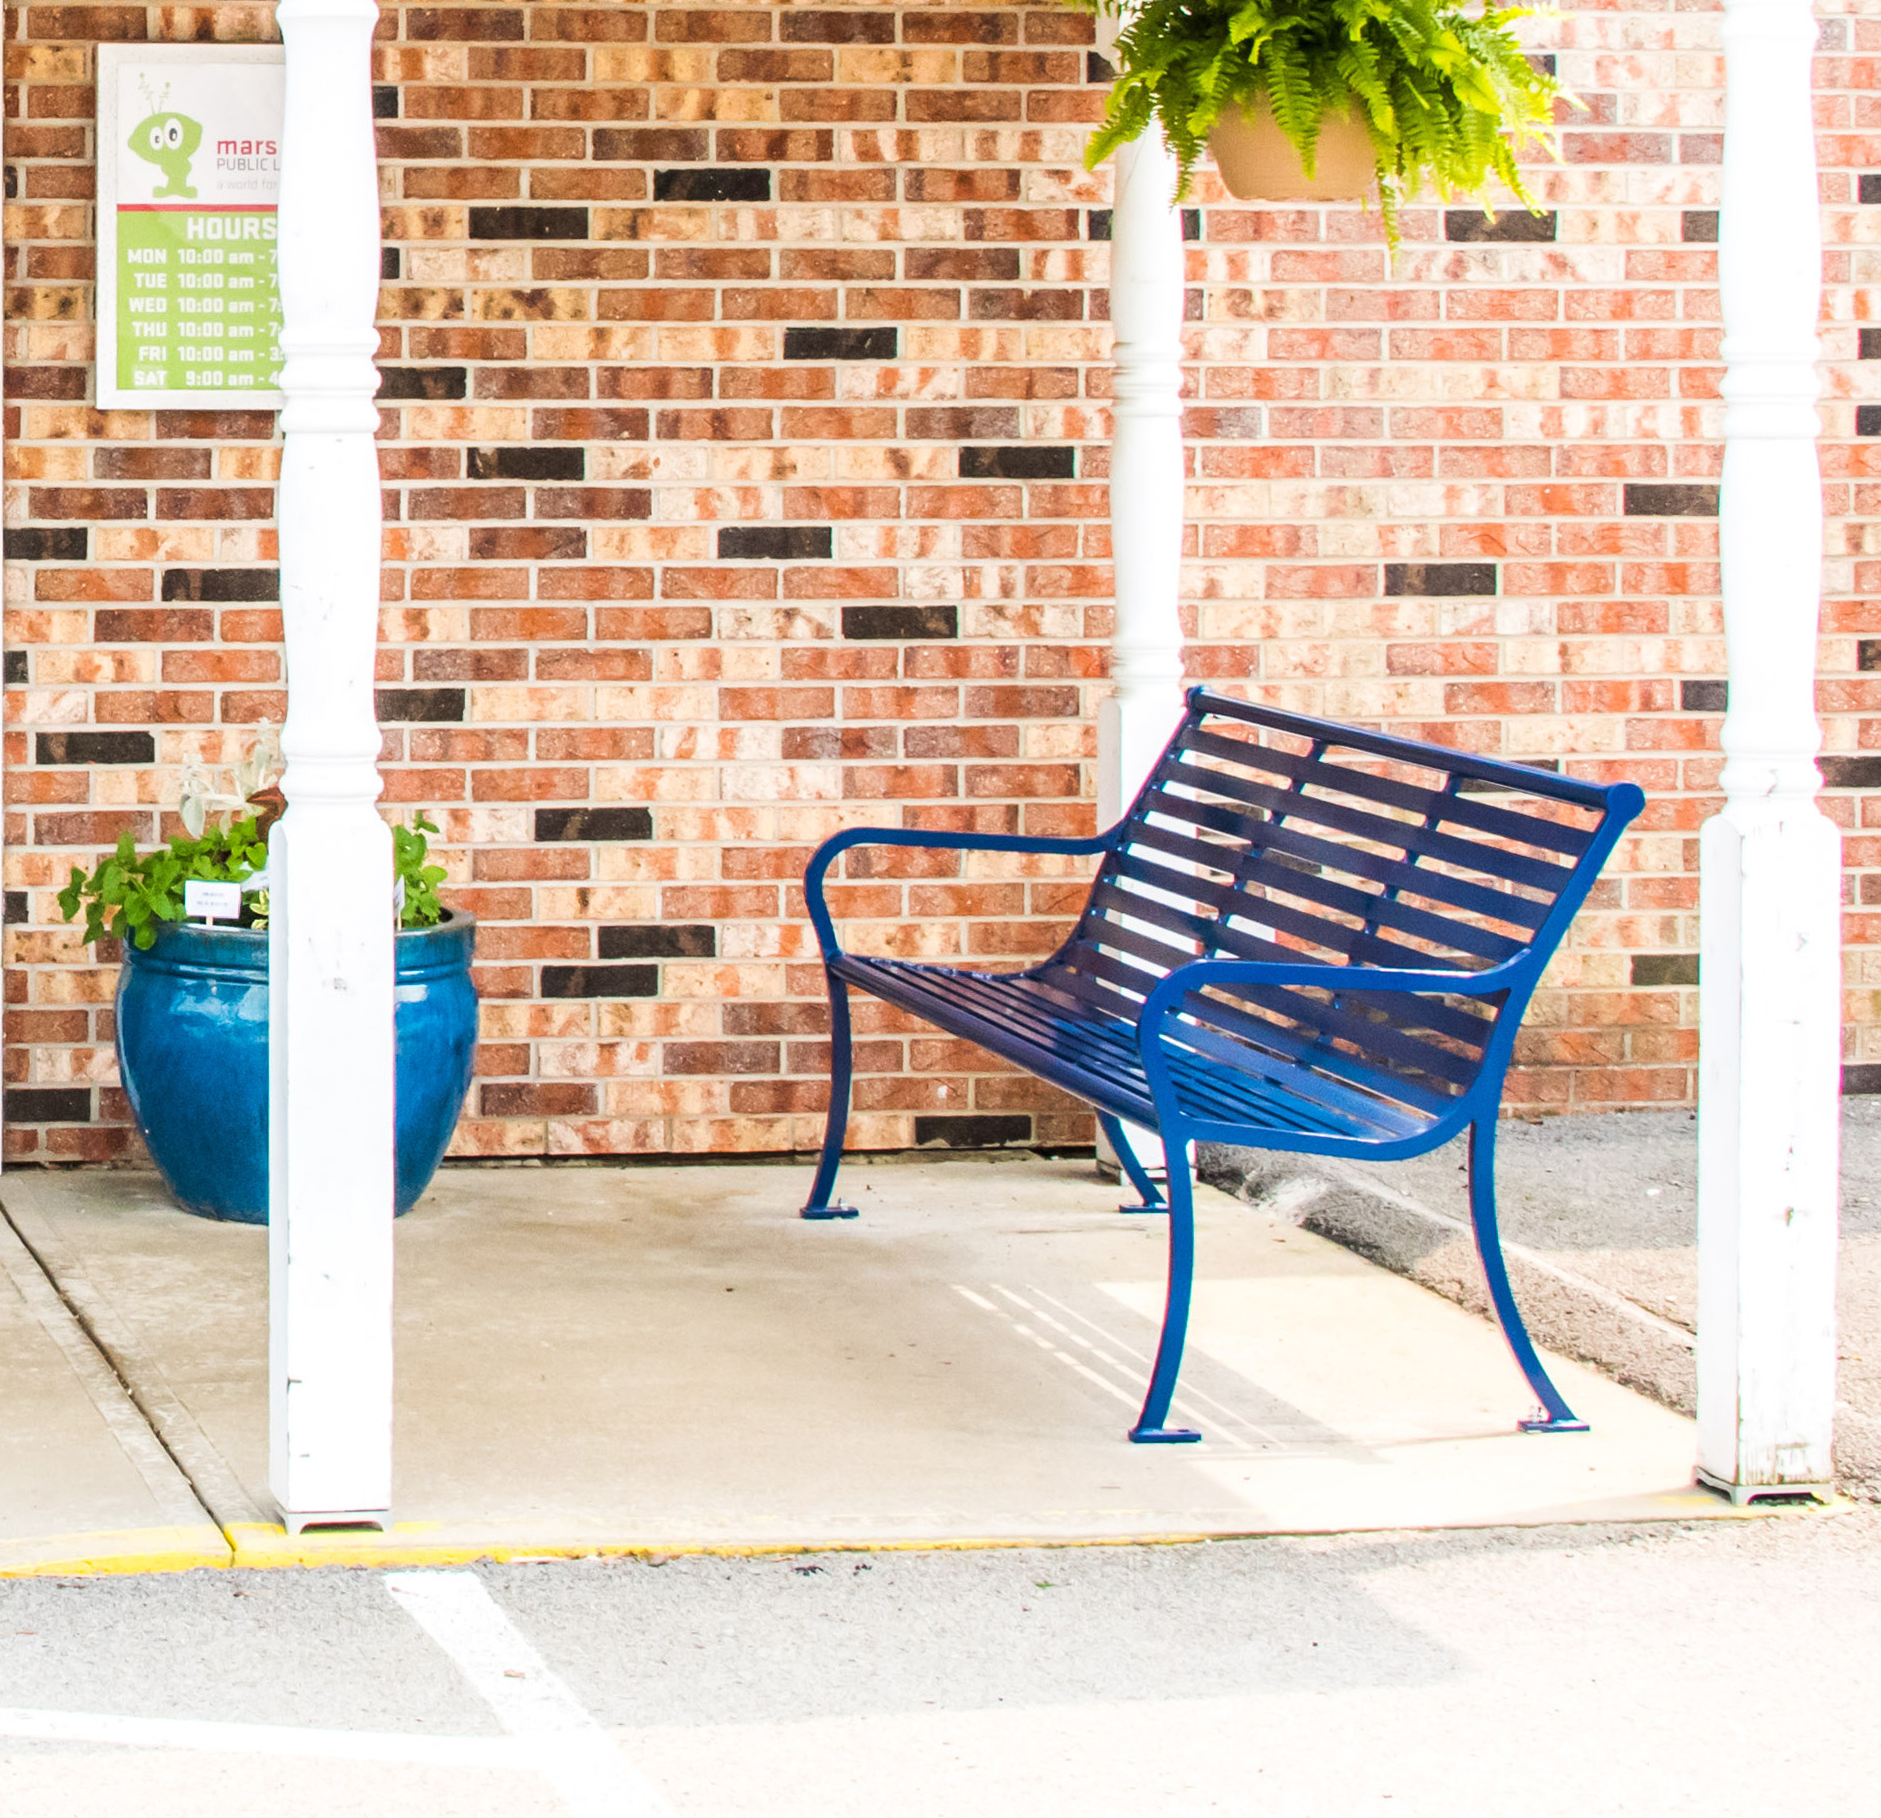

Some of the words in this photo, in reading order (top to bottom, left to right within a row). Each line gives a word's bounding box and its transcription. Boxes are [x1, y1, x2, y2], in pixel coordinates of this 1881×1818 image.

[217, 140, 277, 155] mars
[217, 158, 268, 171] PUBLIC
[273, 158, 281, 171] L
[187, 216, 278, 240] HOURS
[128, 249, 168, 264] MON
[177, 249, 224, 264] 10:00
[228, 253, 254, 264] am
[134, 273, 168, 288] TUE
[177, 273, 224, 288] 10:00
[228, 277, 254, 288] am
[129, 297, 168, 313] WED
[177, 297, 224, 313] 10:00
[228, 301, 254, 313] am
[132, 322, 168, 337] THU
[177, 322, 224, 337] 10:00
[228, 326, 254, 337] am
[139, 346, 168, 361] FRI
[177, 346, 224, 361] 10:00
[228, 350, 254, 361] am
[133, 370, 168, 386] SAT
[185, 370, 224, 386] 9:00
[228, 374, 254, 386] am
